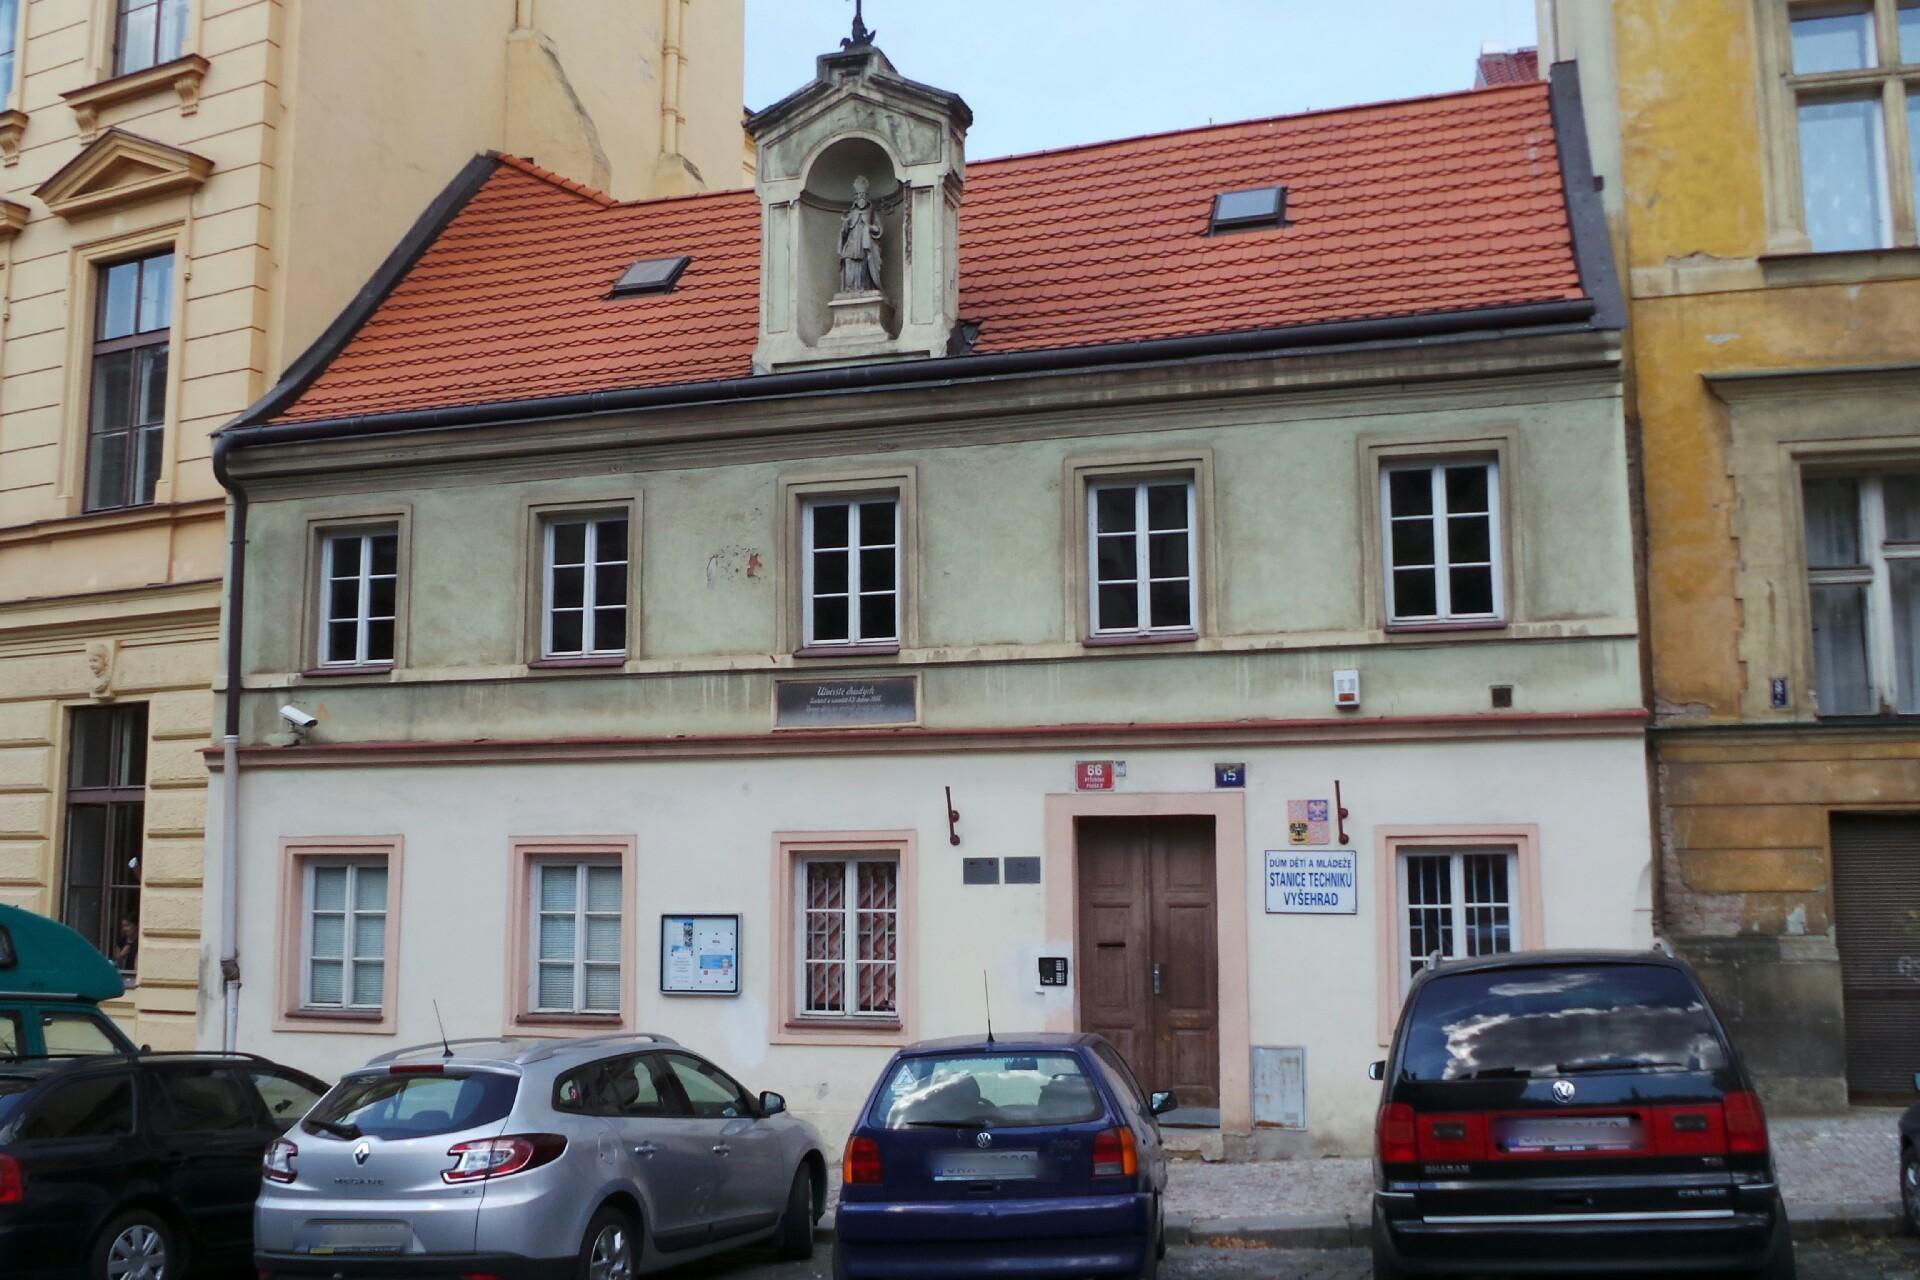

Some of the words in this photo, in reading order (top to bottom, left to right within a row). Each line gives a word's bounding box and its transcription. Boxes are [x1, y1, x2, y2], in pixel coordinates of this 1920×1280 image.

[1087, 764, 1103, 776] 66
[1223, 768, 1237, 781] 15
[1308, 859, 1314, 868] A
[1316, 857, 1352, 868] MLÁDEŽE
[1269, 872, 1306, 888] STANICE
[1283, 888, 1339, 906] VYŠEHRAD
